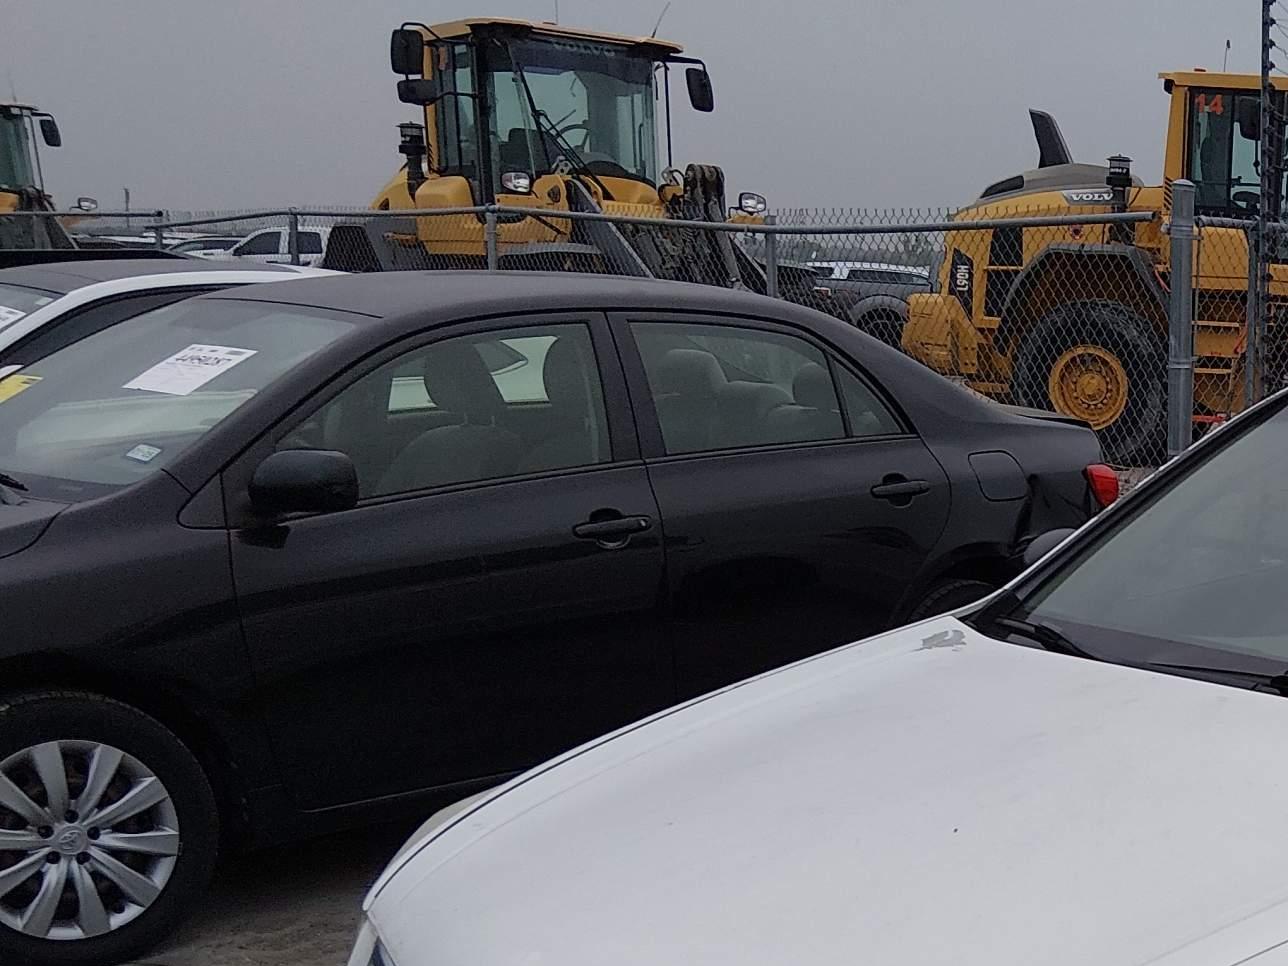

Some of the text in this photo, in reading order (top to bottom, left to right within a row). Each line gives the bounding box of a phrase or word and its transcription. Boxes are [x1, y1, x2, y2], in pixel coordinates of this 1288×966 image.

[1195, 93, 1224, 115] 14
[1071, 193, 1114, 201] VOLV
[956, 265, 969, 291] L90H
